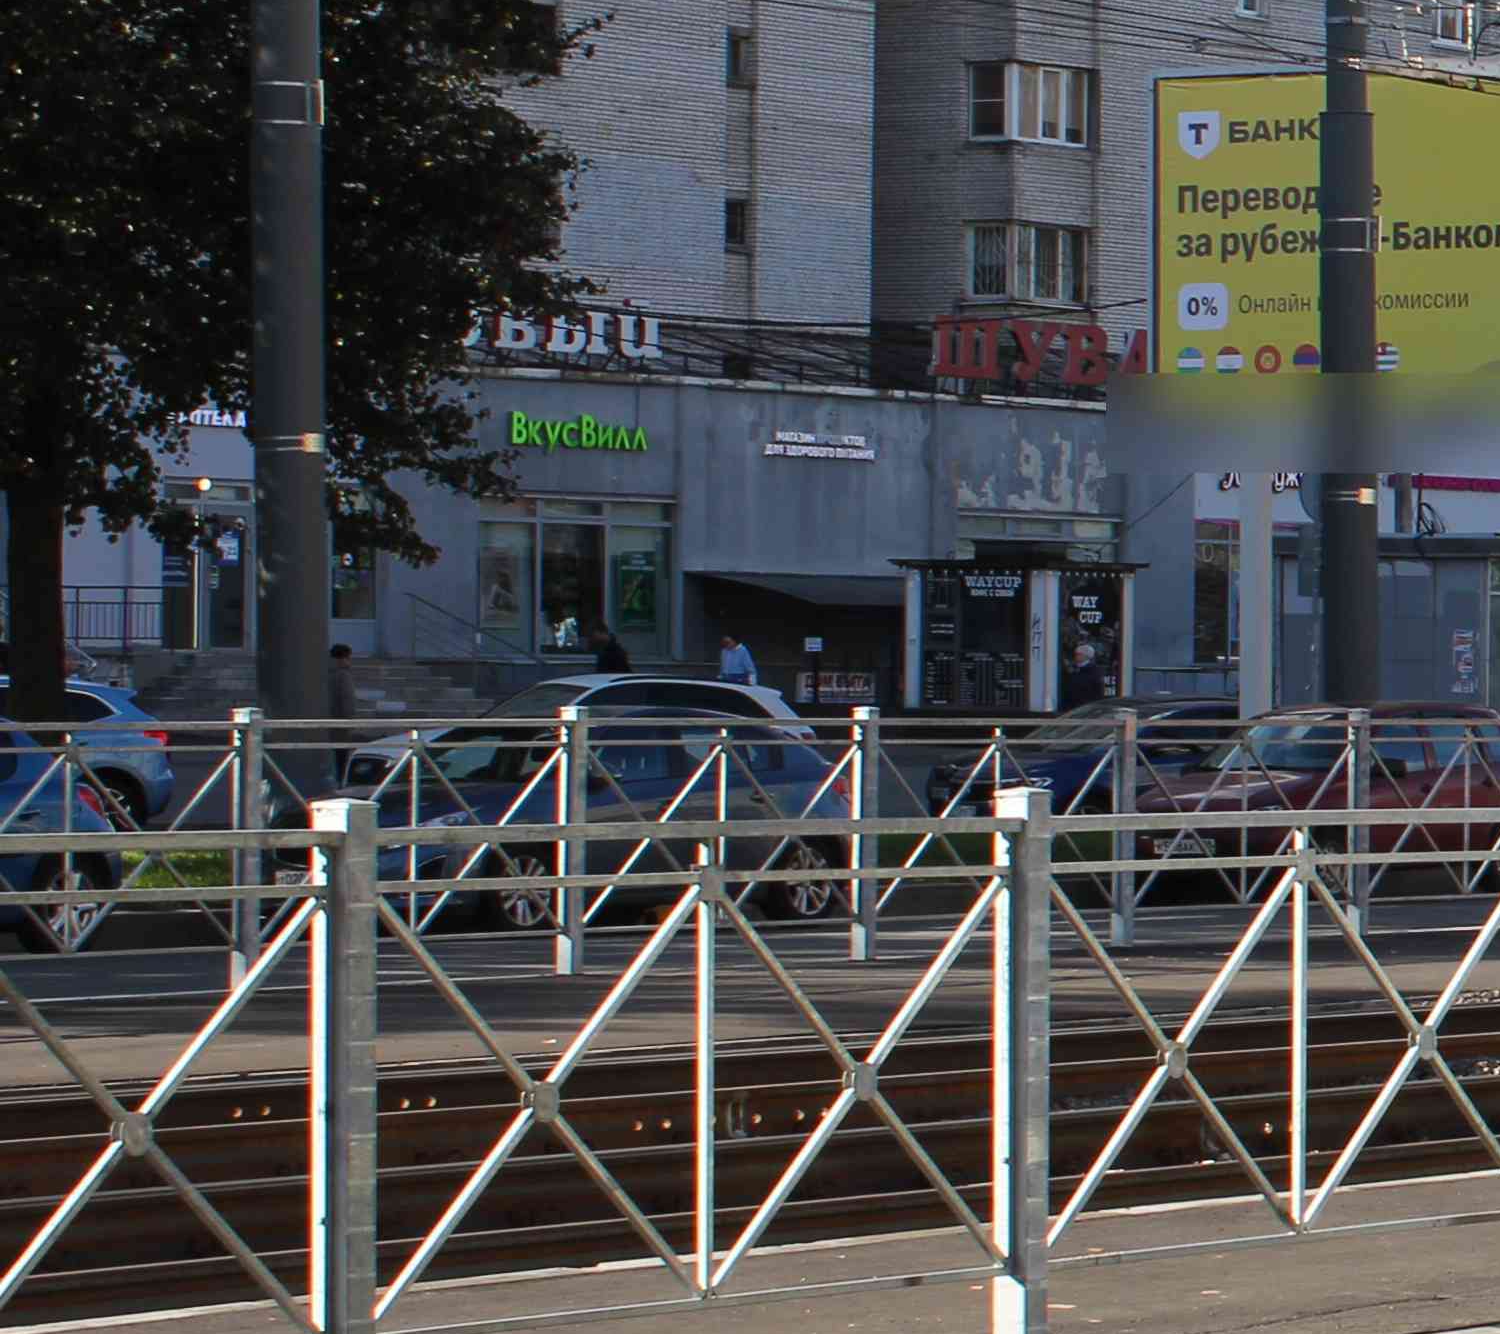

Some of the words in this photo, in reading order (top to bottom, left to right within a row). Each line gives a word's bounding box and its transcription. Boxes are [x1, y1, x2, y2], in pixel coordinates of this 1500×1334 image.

[1187, 122, 1209, 145] Т
[1228, 117, 1320, 143] БАНК
[1176, 233, 1213, 258] за
[1220, 222, 1320, 263] рубеж
[1187, 296, 1219, 317] 0%
[1237, 293, 1313, 315] Онлайн
[511, 410, 649, 453] ВкусВилл
[1071, 595, 1099, 609] WAY
